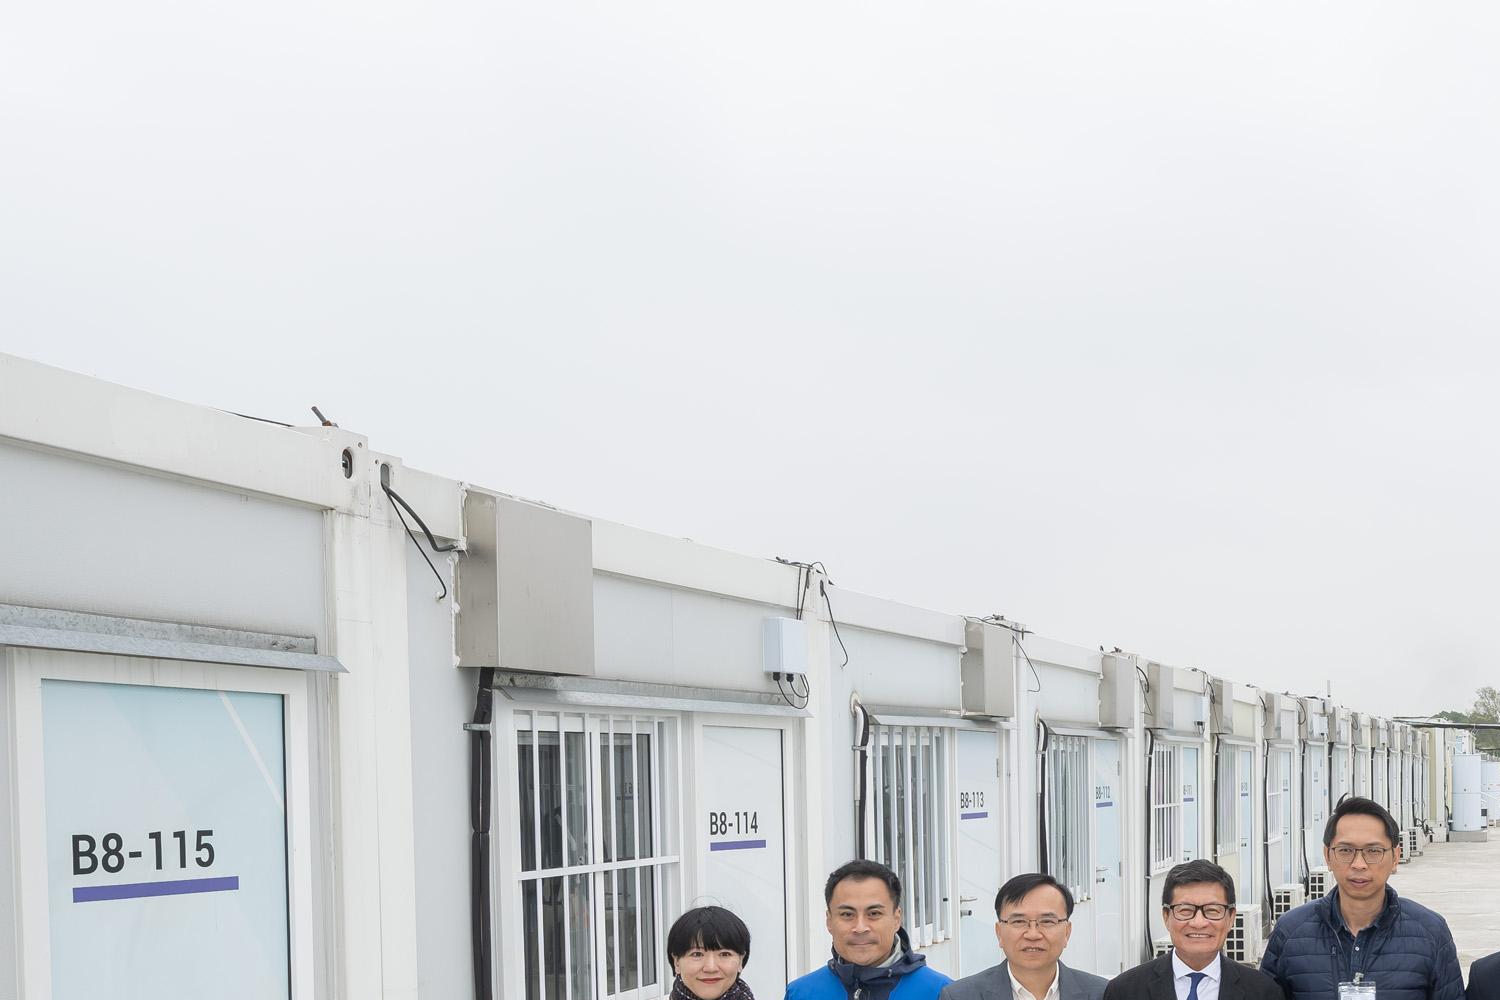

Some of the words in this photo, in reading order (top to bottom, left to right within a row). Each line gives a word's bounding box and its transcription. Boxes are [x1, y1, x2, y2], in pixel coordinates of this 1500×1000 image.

[960, 791, 985, 809] B8-113
[710, 811, 758, 835] B8-114
[71, 829, 215, 876] B8-115
